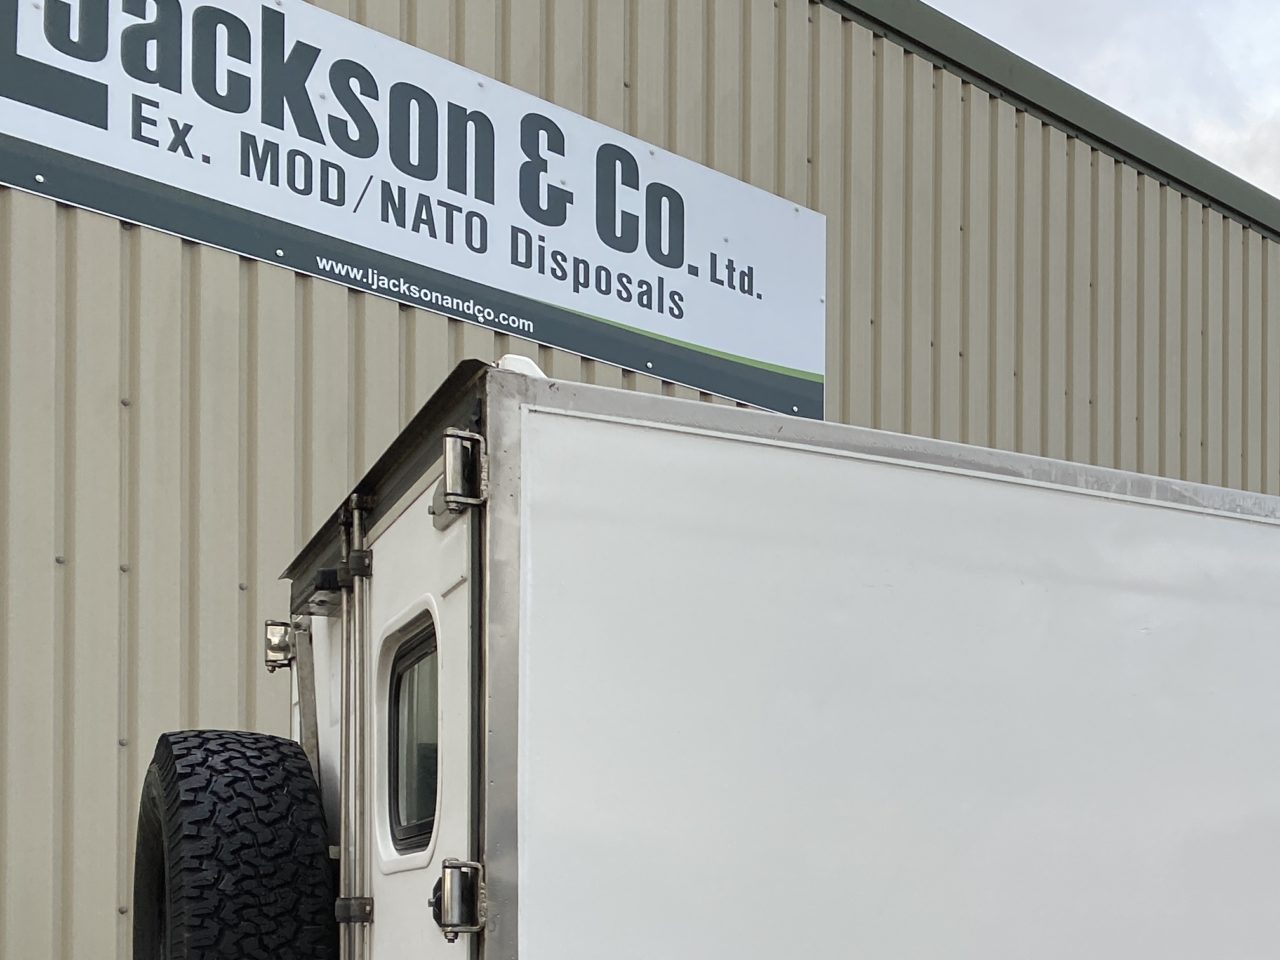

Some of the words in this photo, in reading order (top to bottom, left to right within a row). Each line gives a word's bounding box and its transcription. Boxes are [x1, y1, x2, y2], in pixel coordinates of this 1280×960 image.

[131, 93, 211, 165] Ex.
[240, 131, 488, 255] MOD/NATO
[510, 225, 685, 320] Disposals
[519, 113, 574, 227] &
[596, 143, 699, 278] Co.
[709, 252, 763, 301] Ltd.
